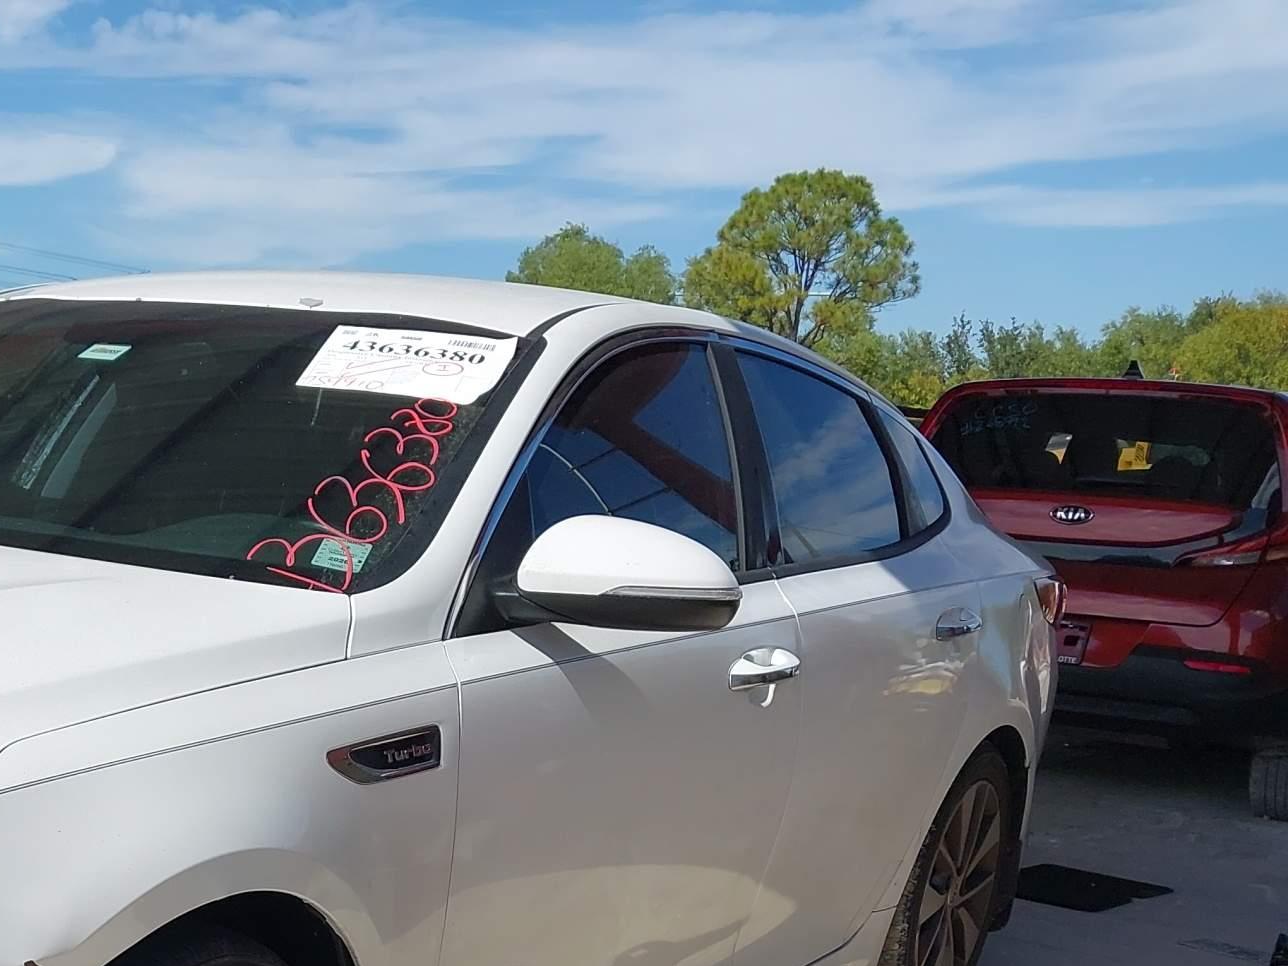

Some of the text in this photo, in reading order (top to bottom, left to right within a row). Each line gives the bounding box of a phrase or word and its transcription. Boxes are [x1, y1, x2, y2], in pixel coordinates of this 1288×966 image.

[342, 338, 486, 365] 43636380
[1056, 506, 1086, 520] KIA
[383, 743, 432, 763] Turbo
